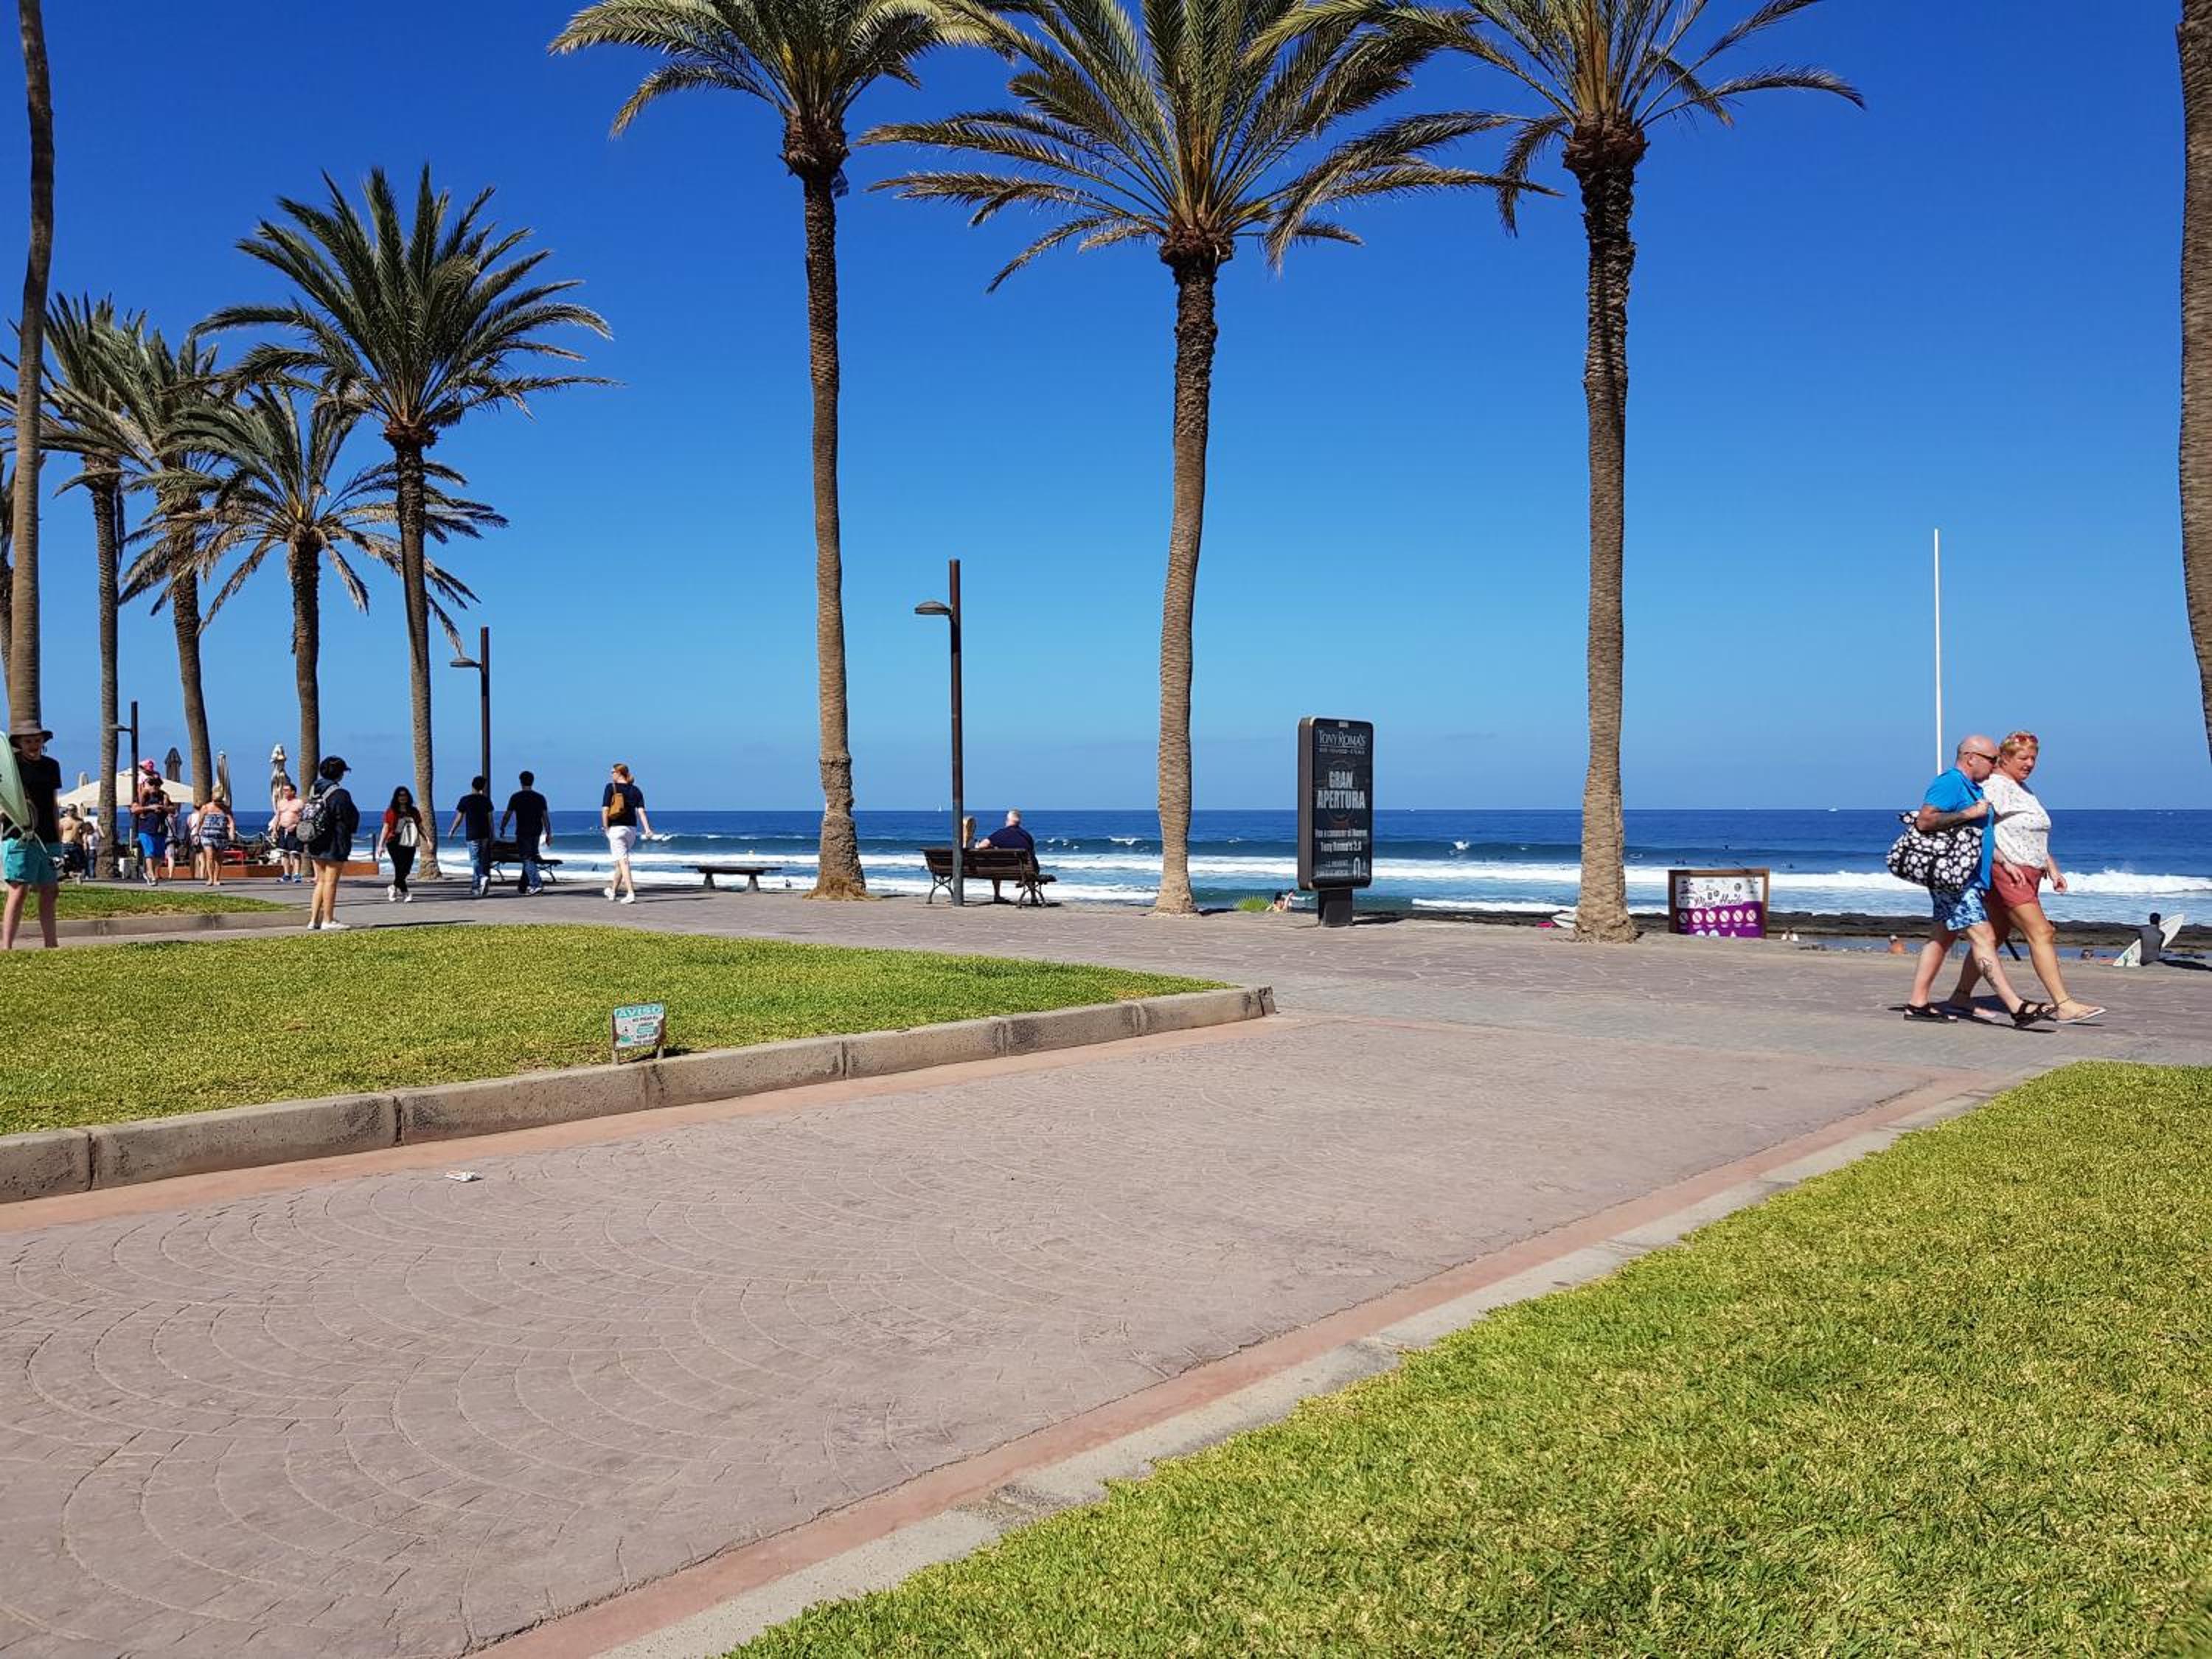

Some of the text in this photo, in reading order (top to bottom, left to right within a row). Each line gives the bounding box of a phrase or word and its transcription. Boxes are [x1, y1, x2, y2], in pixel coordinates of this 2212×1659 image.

[1329, 771, 1353, 789] GRAN
[1316, 790, 1366, 809] APERTURA
[616, 1005, 662, 1018] AVISO
